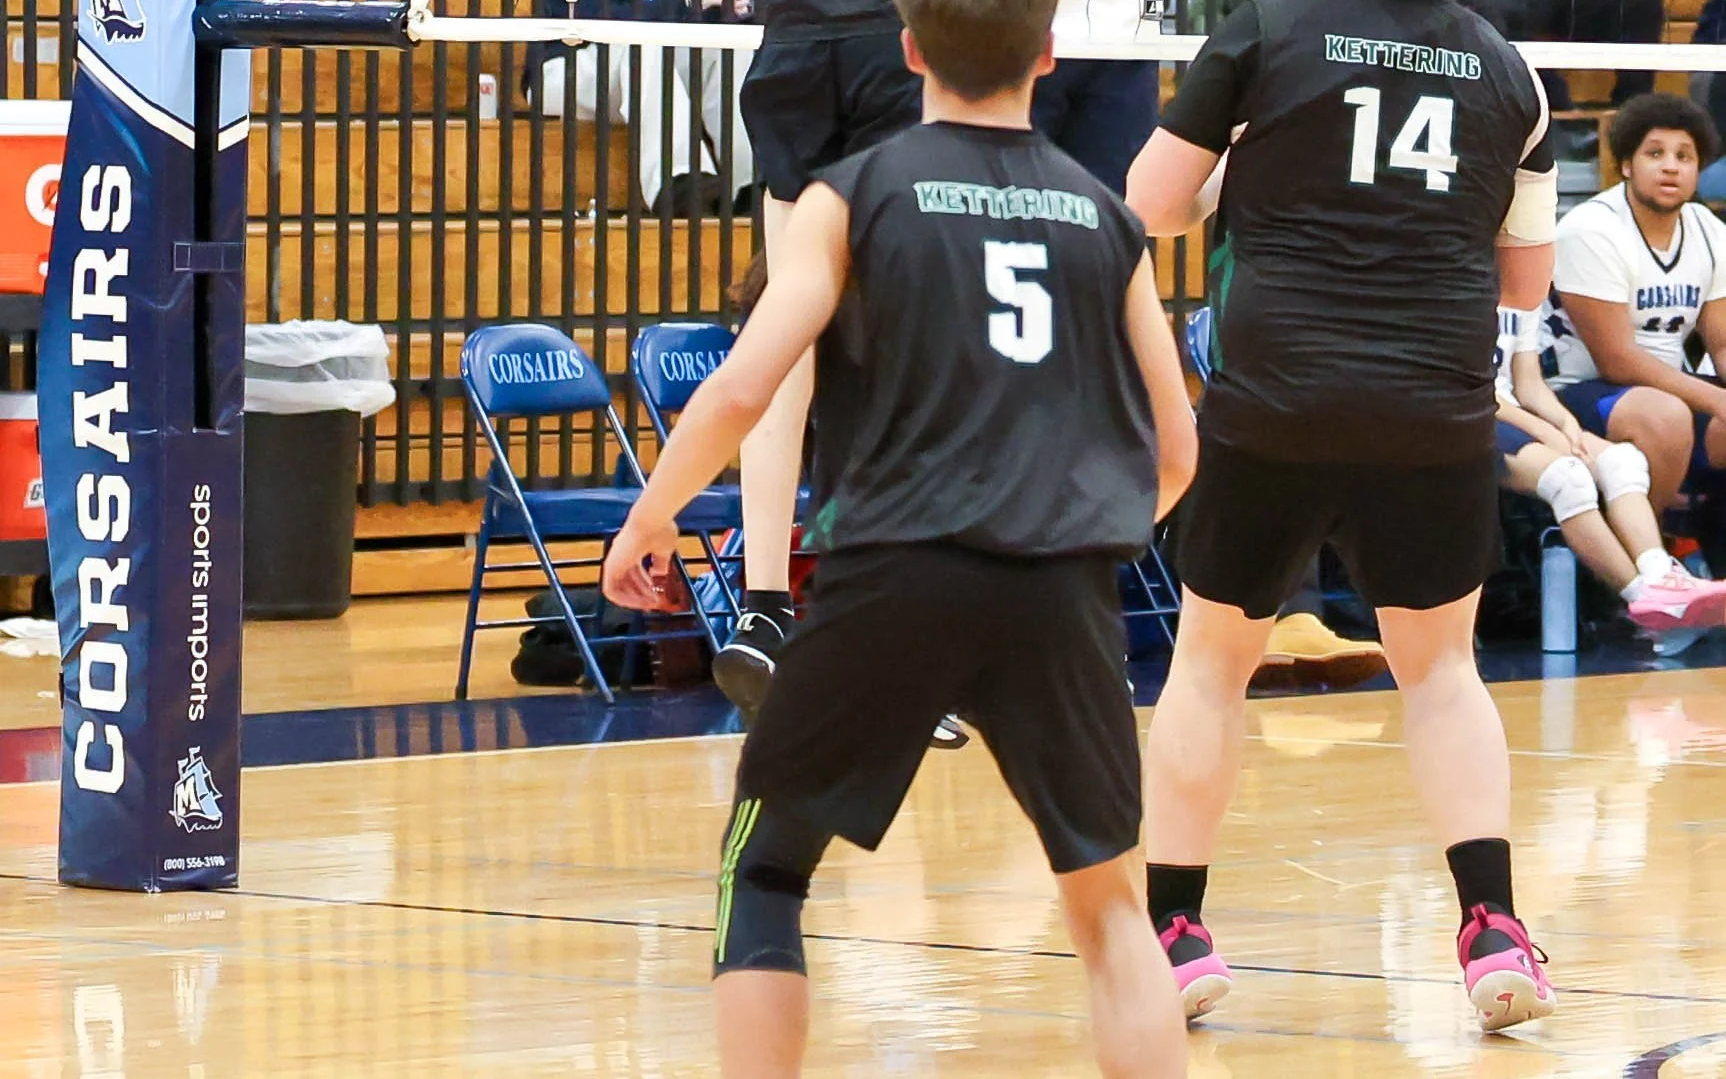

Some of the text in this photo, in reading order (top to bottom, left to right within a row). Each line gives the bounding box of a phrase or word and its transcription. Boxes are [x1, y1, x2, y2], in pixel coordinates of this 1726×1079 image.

[1325, 34, 1481, 80] KETTERING
[1343, 86, 1458, 193] 14
[913, 181, 1099, 230] KETTERING
[983, 240, 1053, 363] 5
[488, 348, 584, 384] CORSAIRS
[70, 164, 134, 795] CORSAIRS
[187, 484, 212, 721] sports imports
[163, 858, 185, 871] (800)
